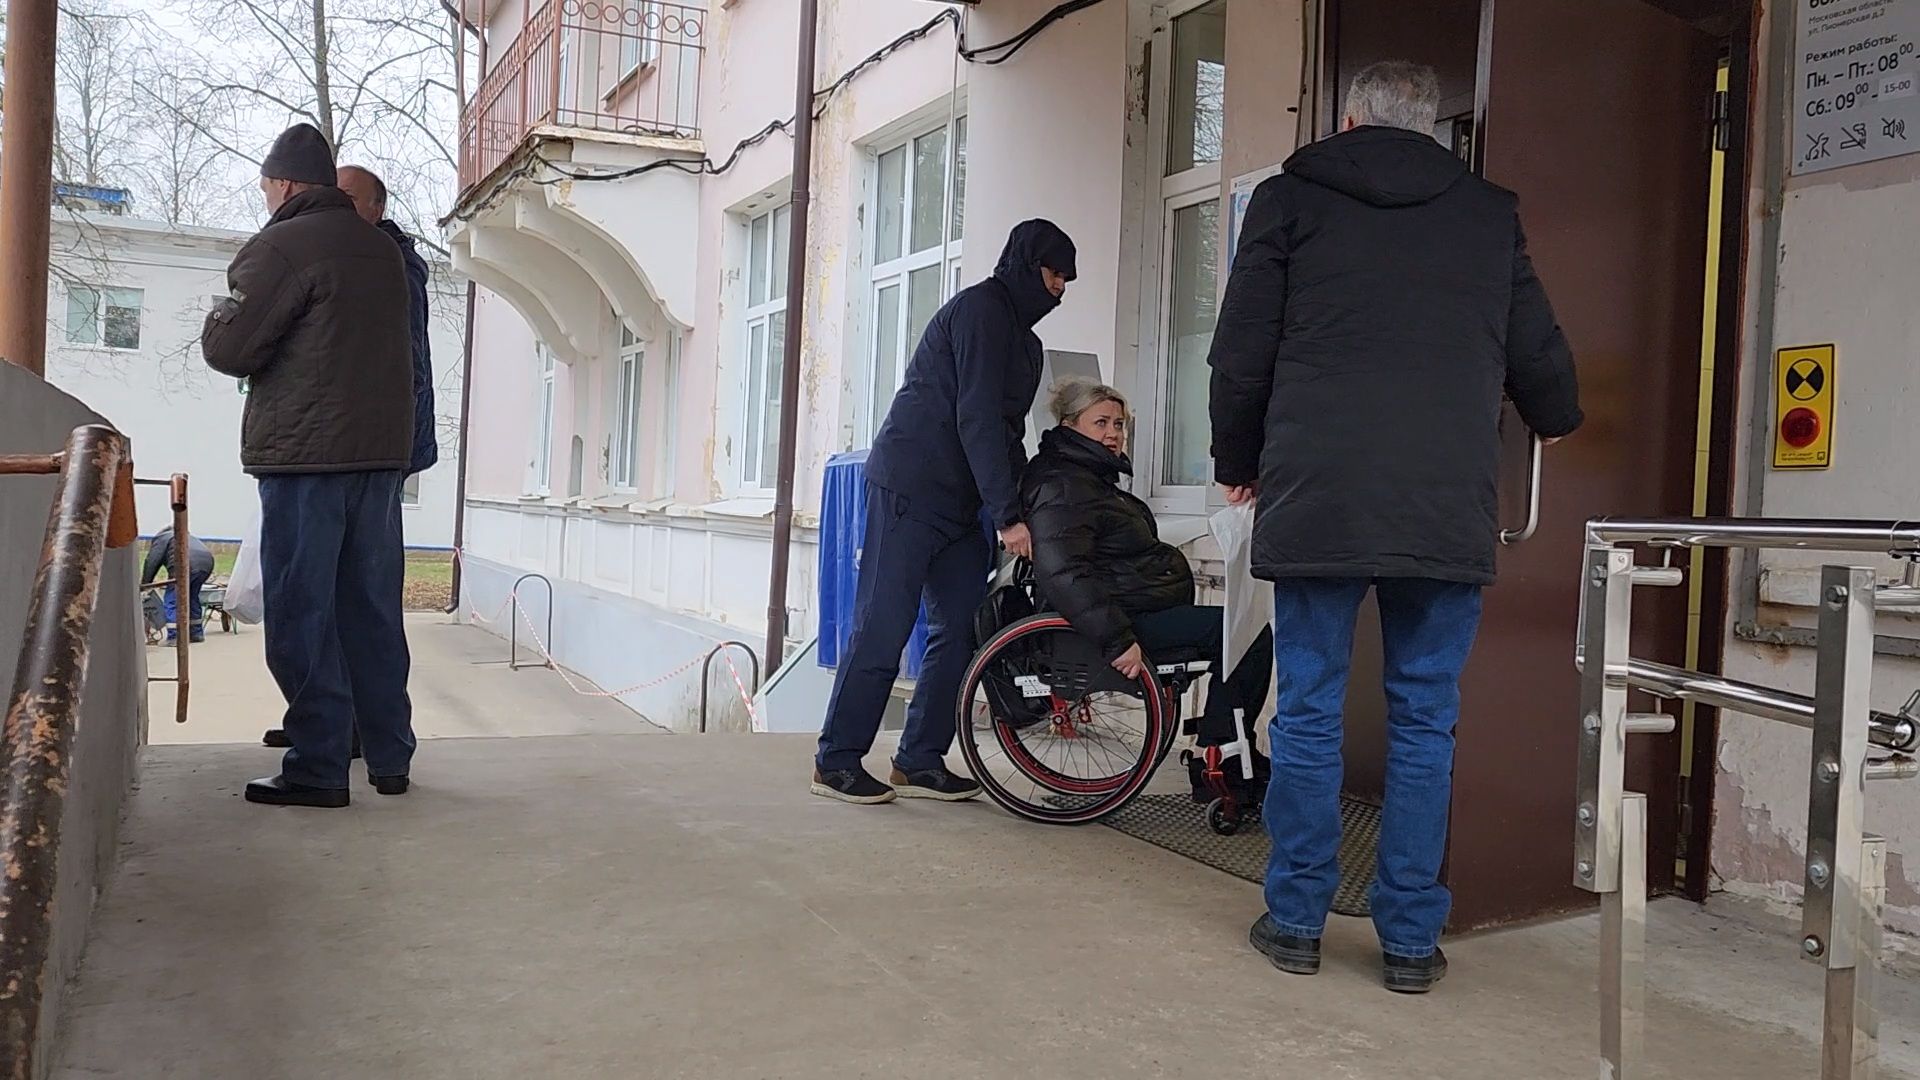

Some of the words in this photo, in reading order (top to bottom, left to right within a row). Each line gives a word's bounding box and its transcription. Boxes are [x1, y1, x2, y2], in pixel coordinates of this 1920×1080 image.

[1808, 6, 1857, 24] Московская
[1821, 14, 1870, 32] Пионерская
[1806, 47, 1845, 63] Режим
[1848, 34, 1898, 55] работы:
[1807, 72, 1830, 89] Пн.
[1884, 80, 1911, 94] 15-00
